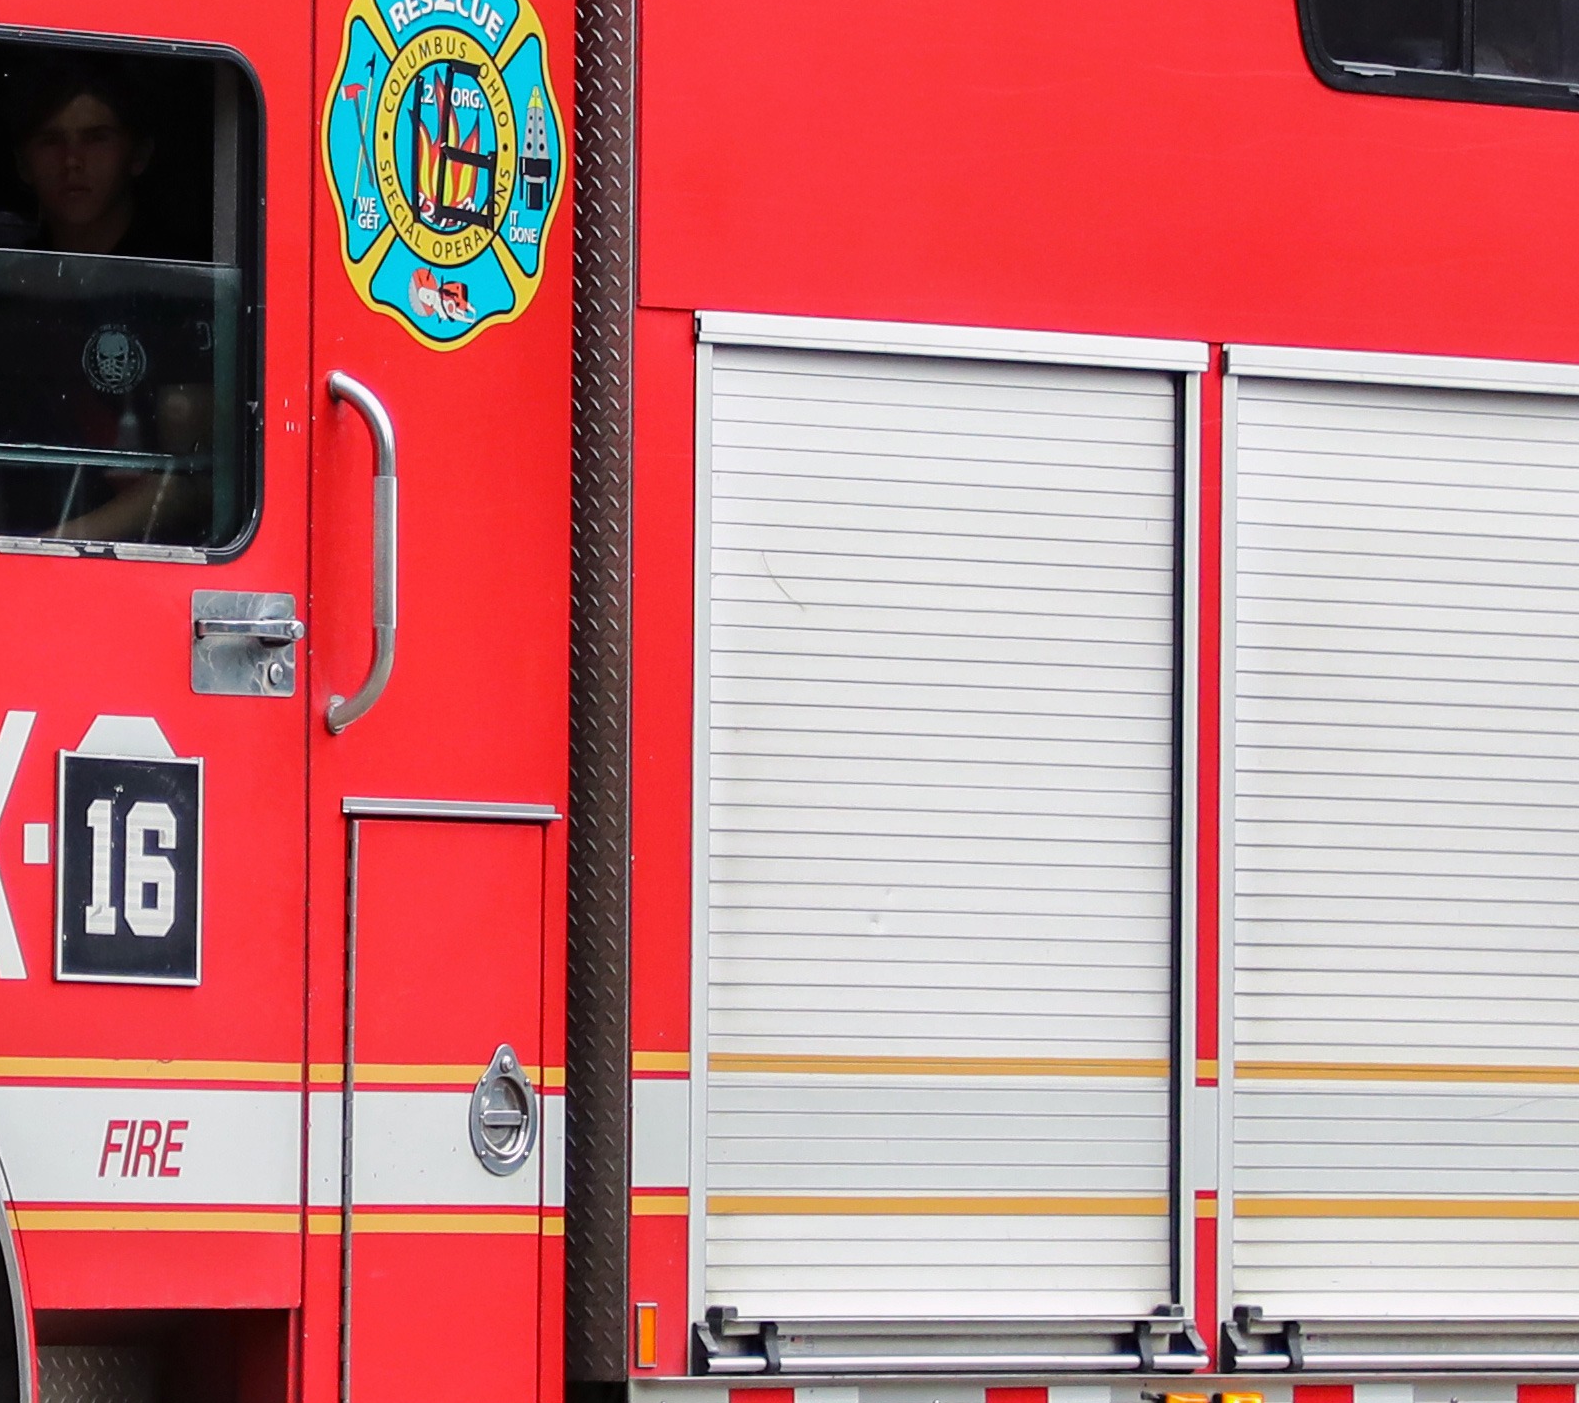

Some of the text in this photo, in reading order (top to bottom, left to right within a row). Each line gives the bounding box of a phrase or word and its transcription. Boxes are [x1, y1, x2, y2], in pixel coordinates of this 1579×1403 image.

[384, 36, 509, 128] COLUMBUS OHIO
[450, 87, 484, 109] ORG.
[357, 196, 377, 213] WE
[379, 159, 422, 249] SPECIAL
[432, 167, 511, 259] OPERAONS
[357, 214, 380, 229] GET
[509, 209, 519, 225] IT
[509, 227, 538, 244] DONE
[83, 799, 177, 938] 16
[98, 1119, 190, 1179] FIRE
